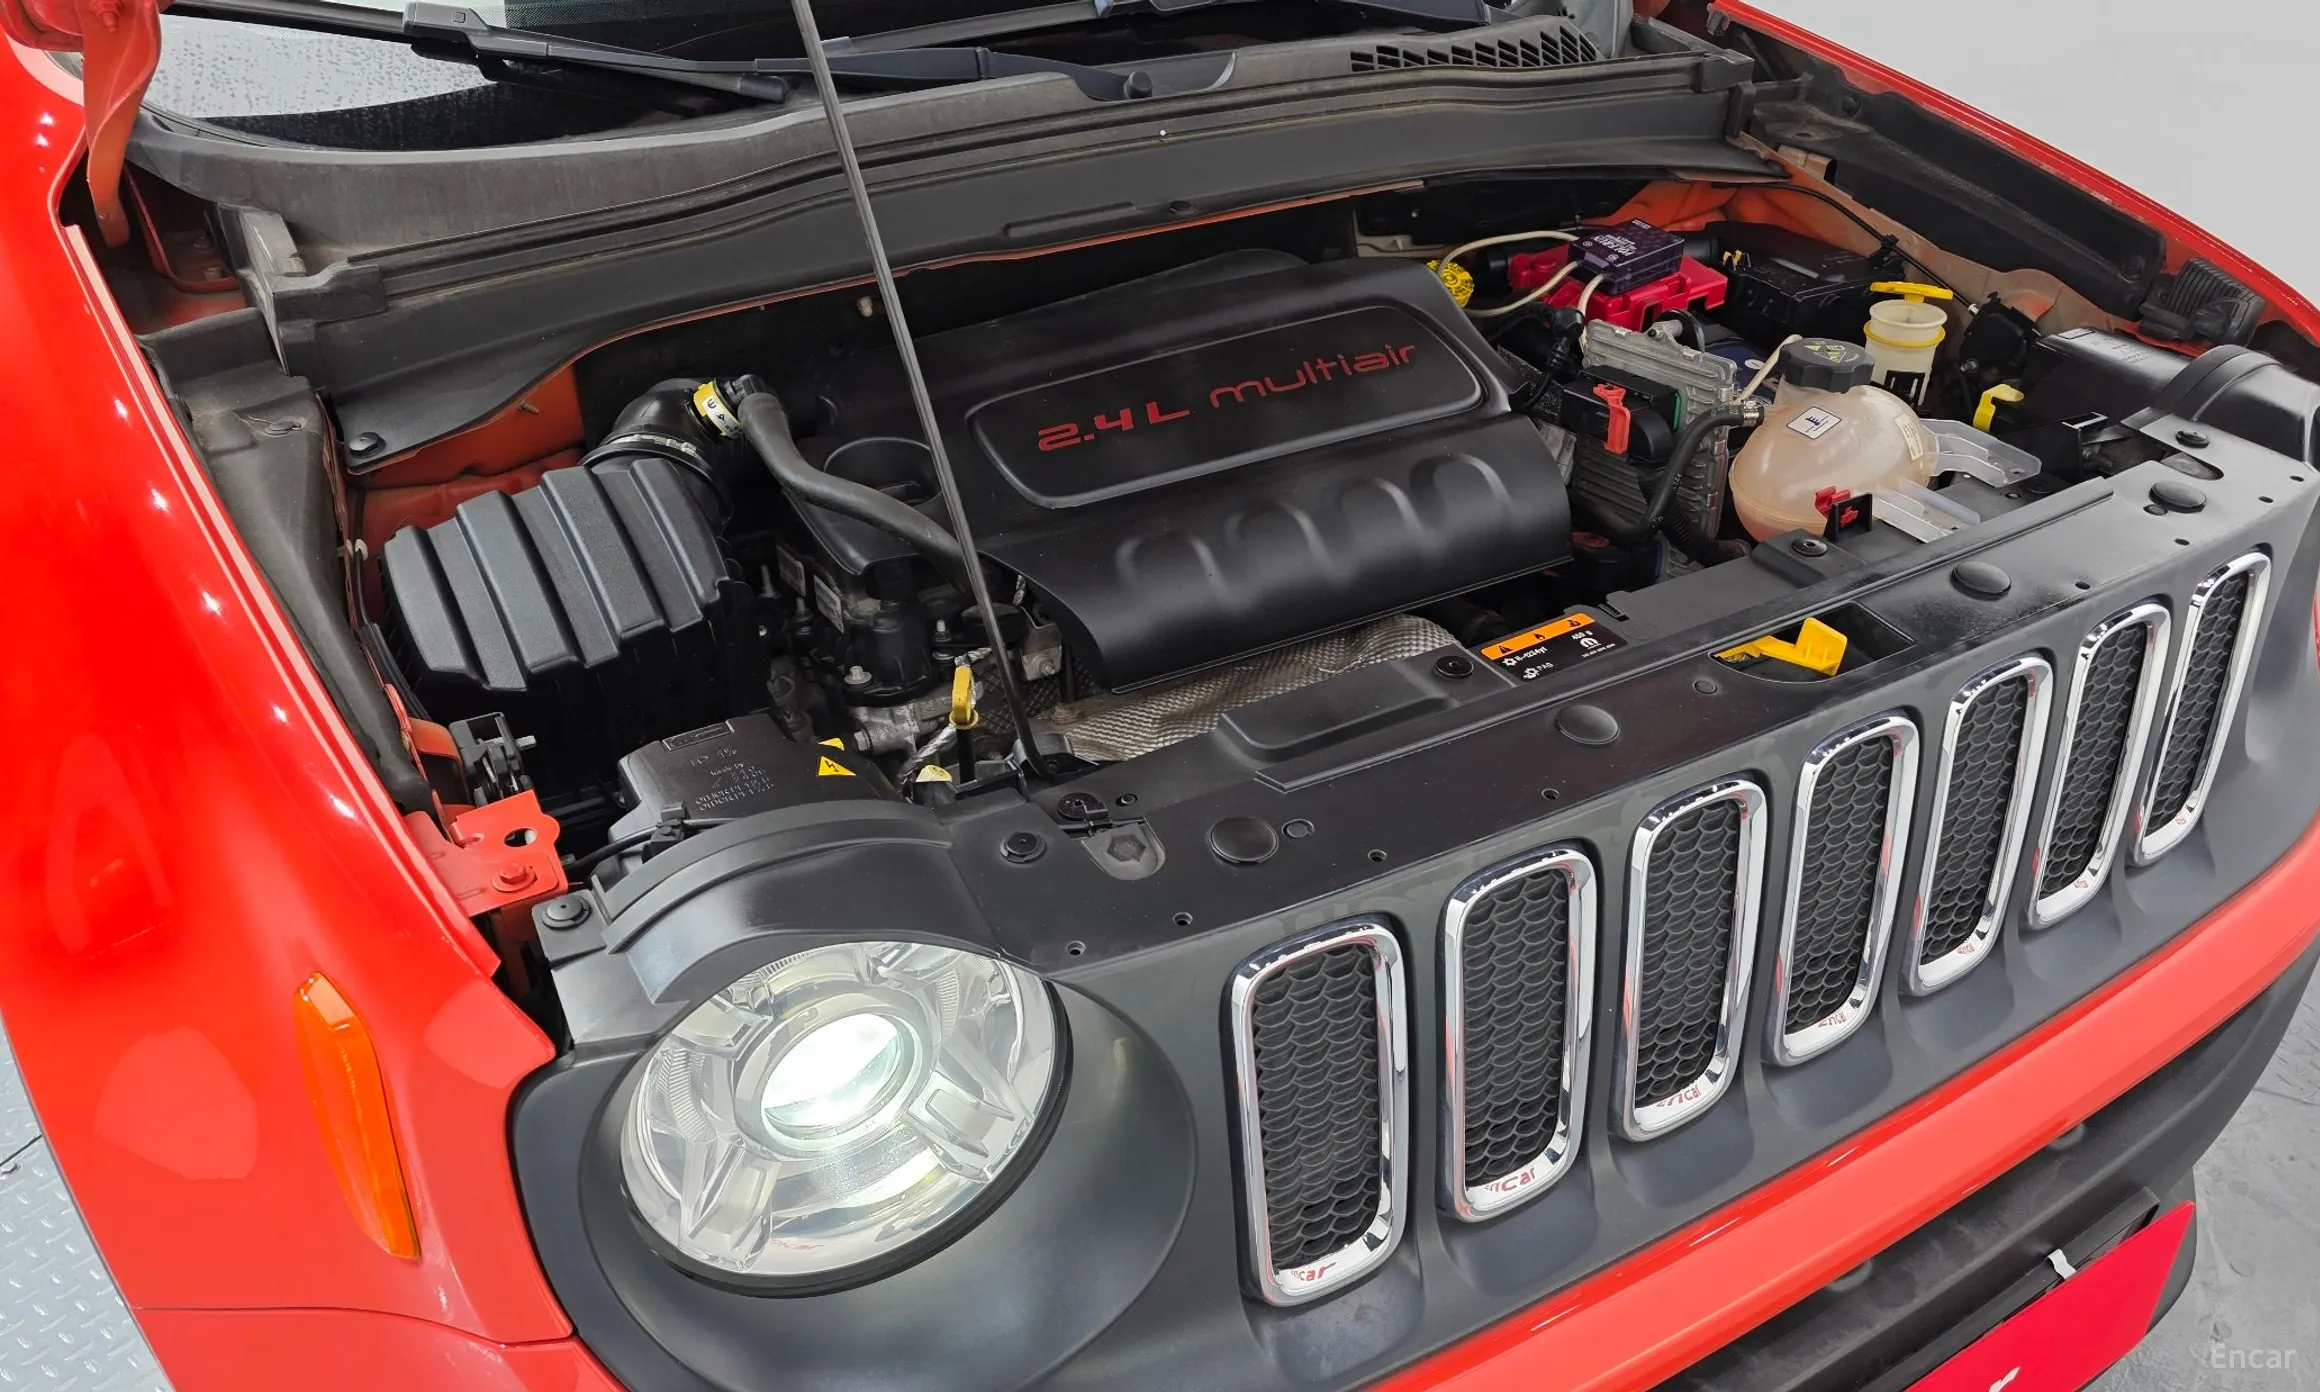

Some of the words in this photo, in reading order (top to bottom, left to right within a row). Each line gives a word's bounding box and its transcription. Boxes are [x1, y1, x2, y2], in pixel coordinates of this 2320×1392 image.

[1038, 408, 1134, 452] 2.4
[1147, 401, 1190, 424] L
[1209, 344, 1416, 408] multiair
